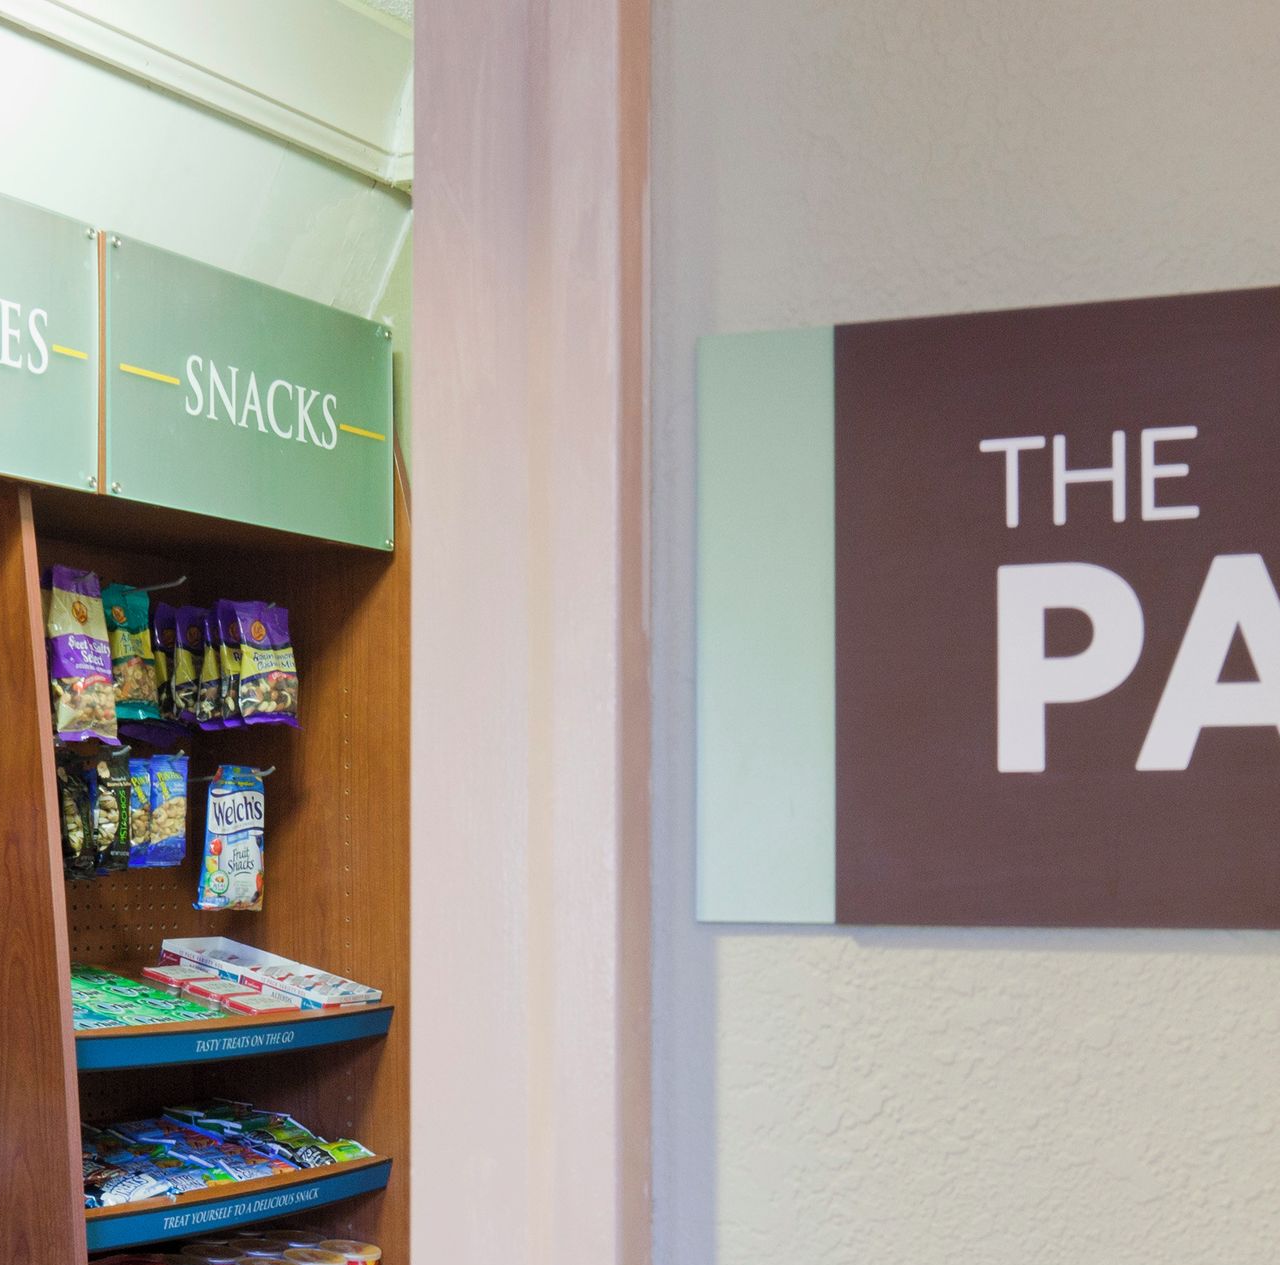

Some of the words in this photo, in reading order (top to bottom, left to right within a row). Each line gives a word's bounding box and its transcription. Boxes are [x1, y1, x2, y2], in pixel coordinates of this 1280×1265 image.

[185, 355, 338, 451] SNACKS
[978, 426, 1200, 529] THE
[212, 796, 264, 828] Welch's
[227, 857, 256, 873] Snacks
[232, 847, 250, 861] Fruit
[196, 1037, 221, 1054] TASTY
[221, 1034, 250, 1051] TREATS
[250, 1034, 265, 1047] ON
[265, 1032, 283, 1045] THE
[282, 1031, 295, 1043] GO
[163, 1214, 190, 1230] TREAT
[191, 1205, 232, 1226] YOURSELF
[234, 1203, 246, 1216] TO
[245, 1203, 253, 1214] A
[253, 1191, 295, 1213] DELICIOUS
[295, 1187, 320, 1204] SNACK
